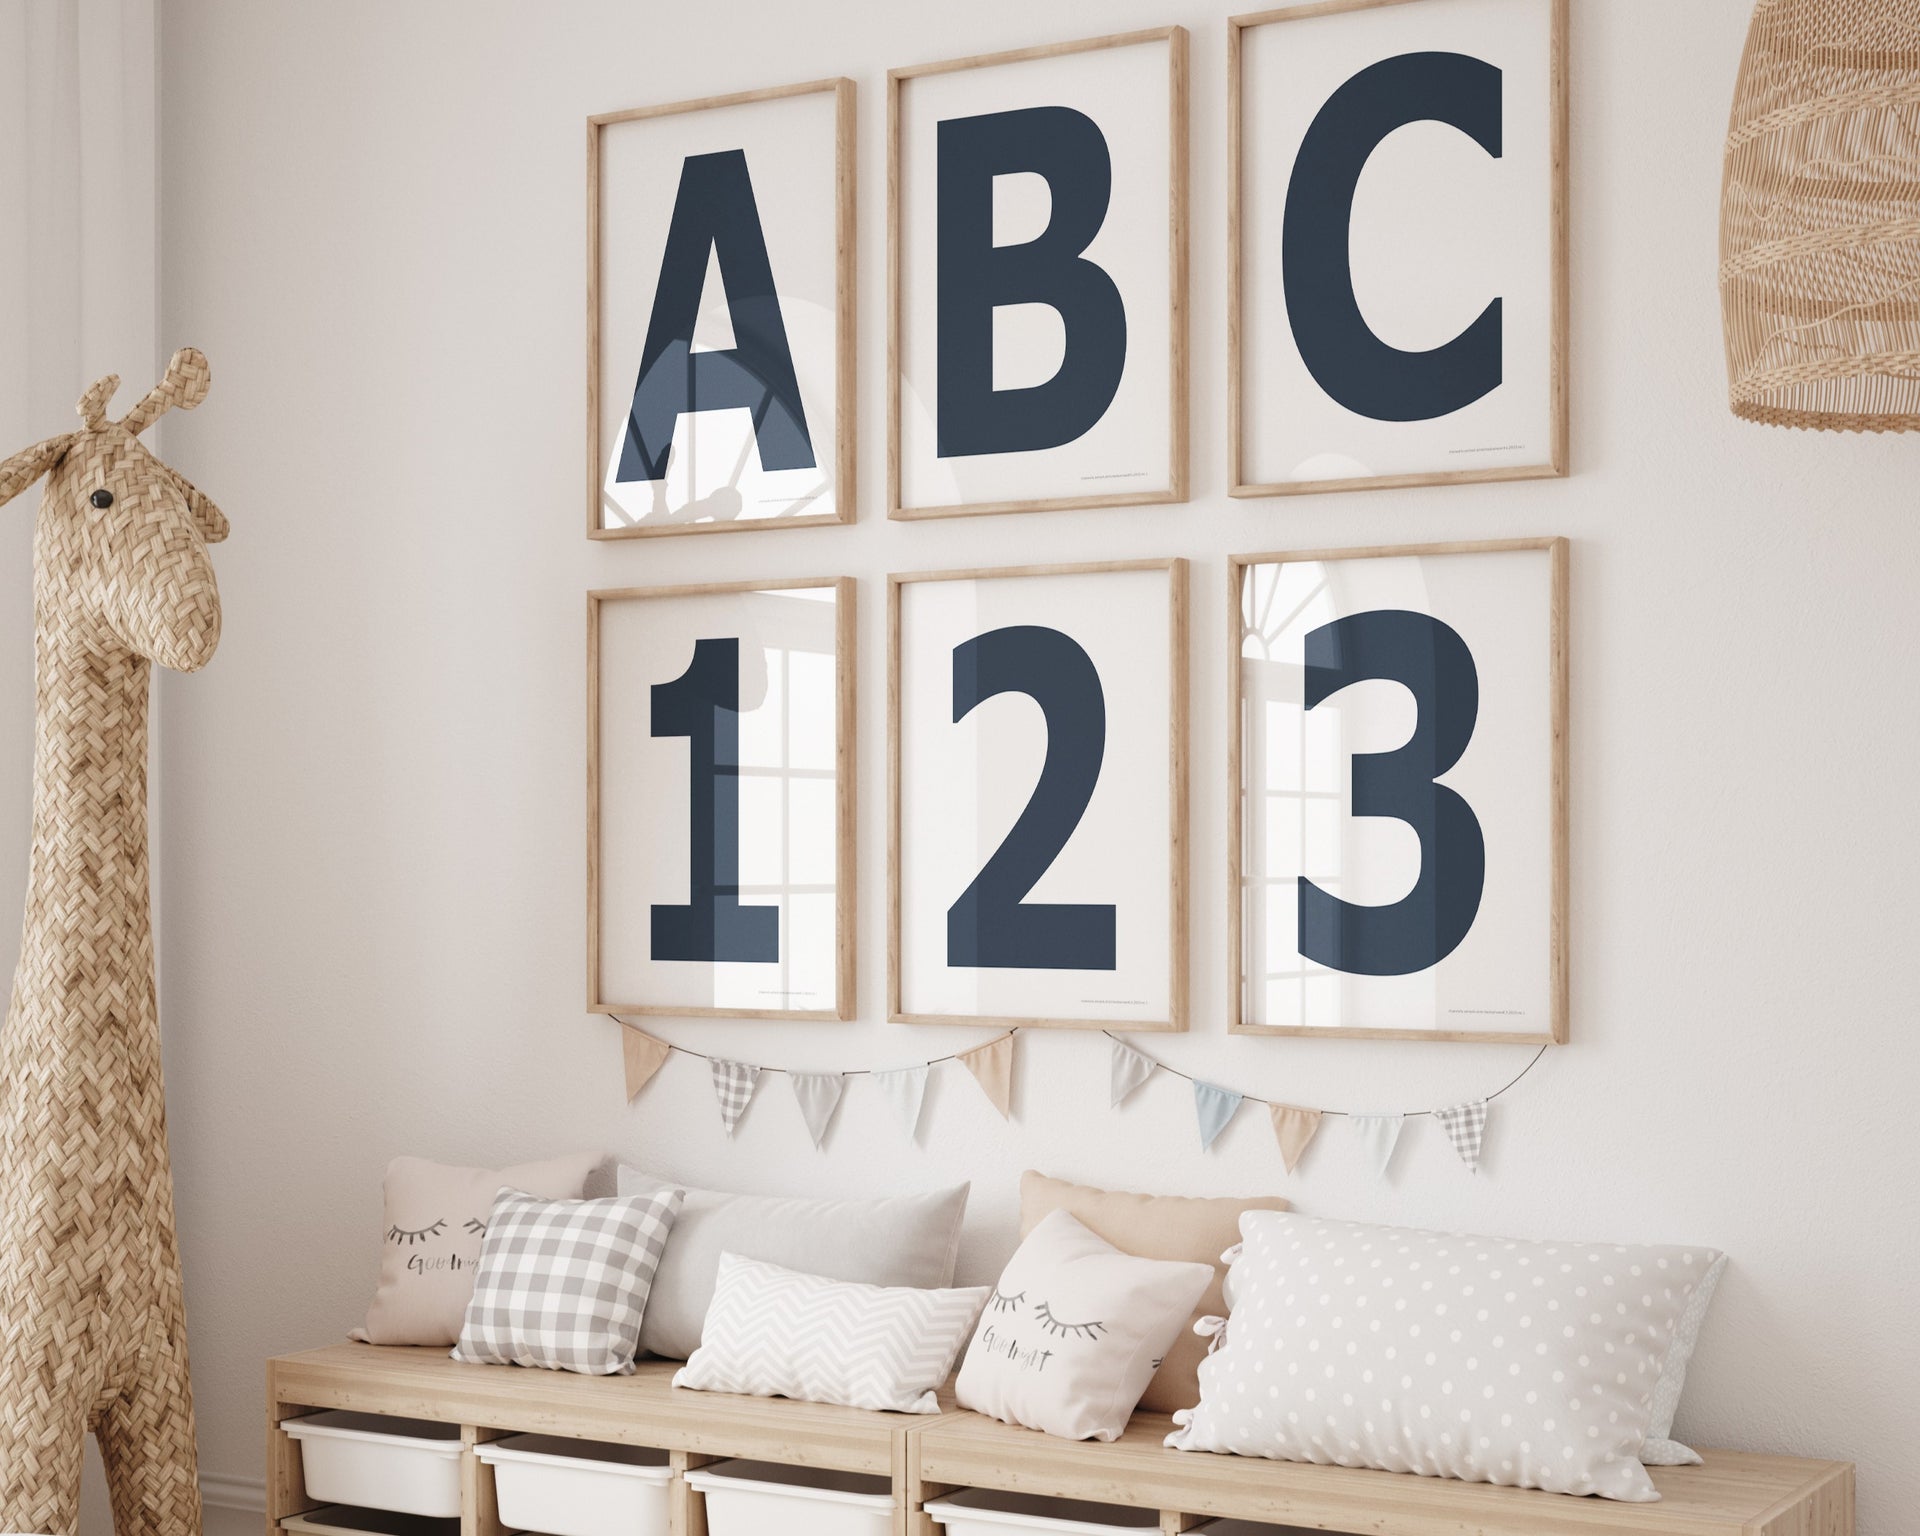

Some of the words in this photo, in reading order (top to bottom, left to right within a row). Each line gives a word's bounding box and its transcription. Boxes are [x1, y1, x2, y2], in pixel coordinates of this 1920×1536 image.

[616, 149, 816, 482] A
[936, 106, 1127, 459] B
[1282, 51, 1503, 422] C
[651, 637, 779, 963] 1
[947, 625, 1117, 971] 2
[1297, 609, 1485, 977] 3
